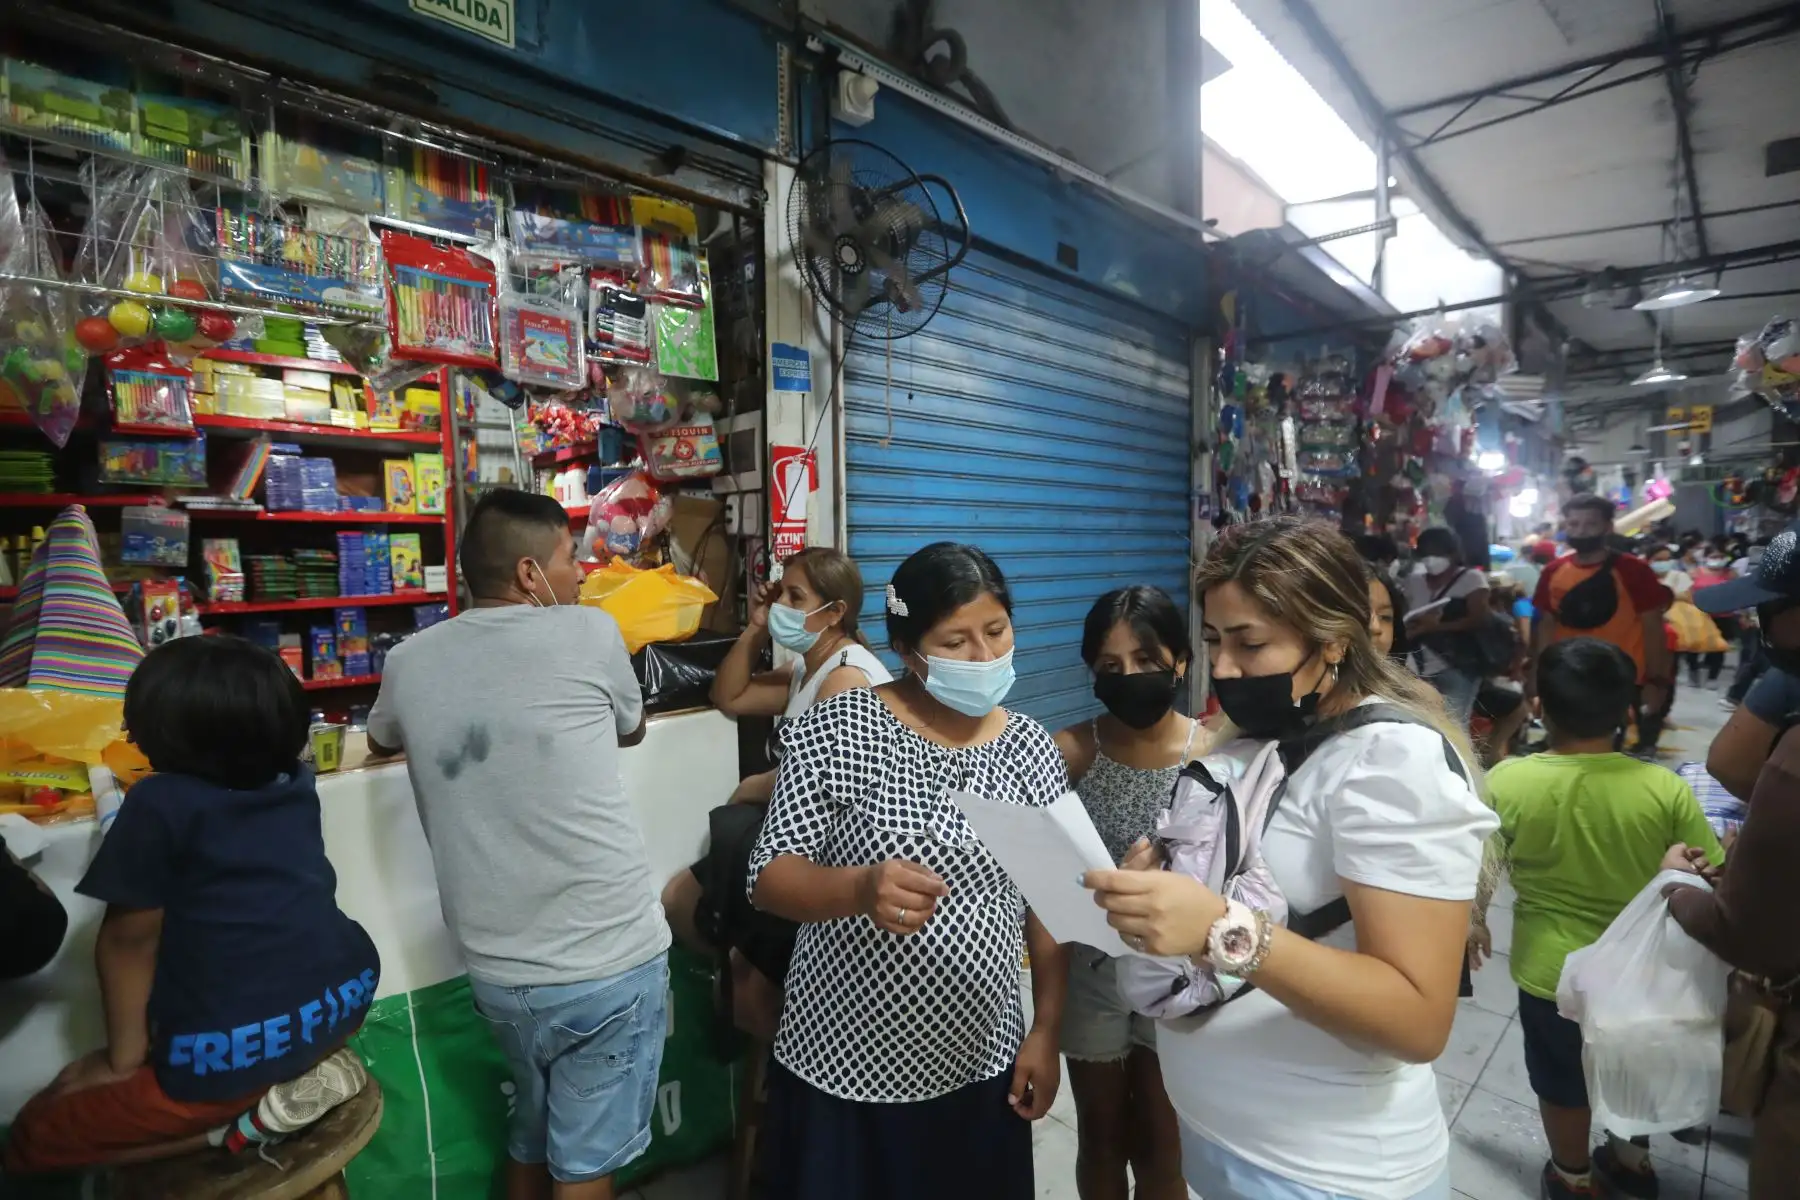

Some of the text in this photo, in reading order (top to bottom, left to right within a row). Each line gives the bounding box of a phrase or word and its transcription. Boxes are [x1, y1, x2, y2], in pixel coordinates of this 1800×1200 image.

[428, 0, 502, 30] ALIDA
[655, 427, 709, 438] OTIQUIN
[773, 532, 805, 545] XTINT
[169, 967, 377, 1076] FREE FIRE
